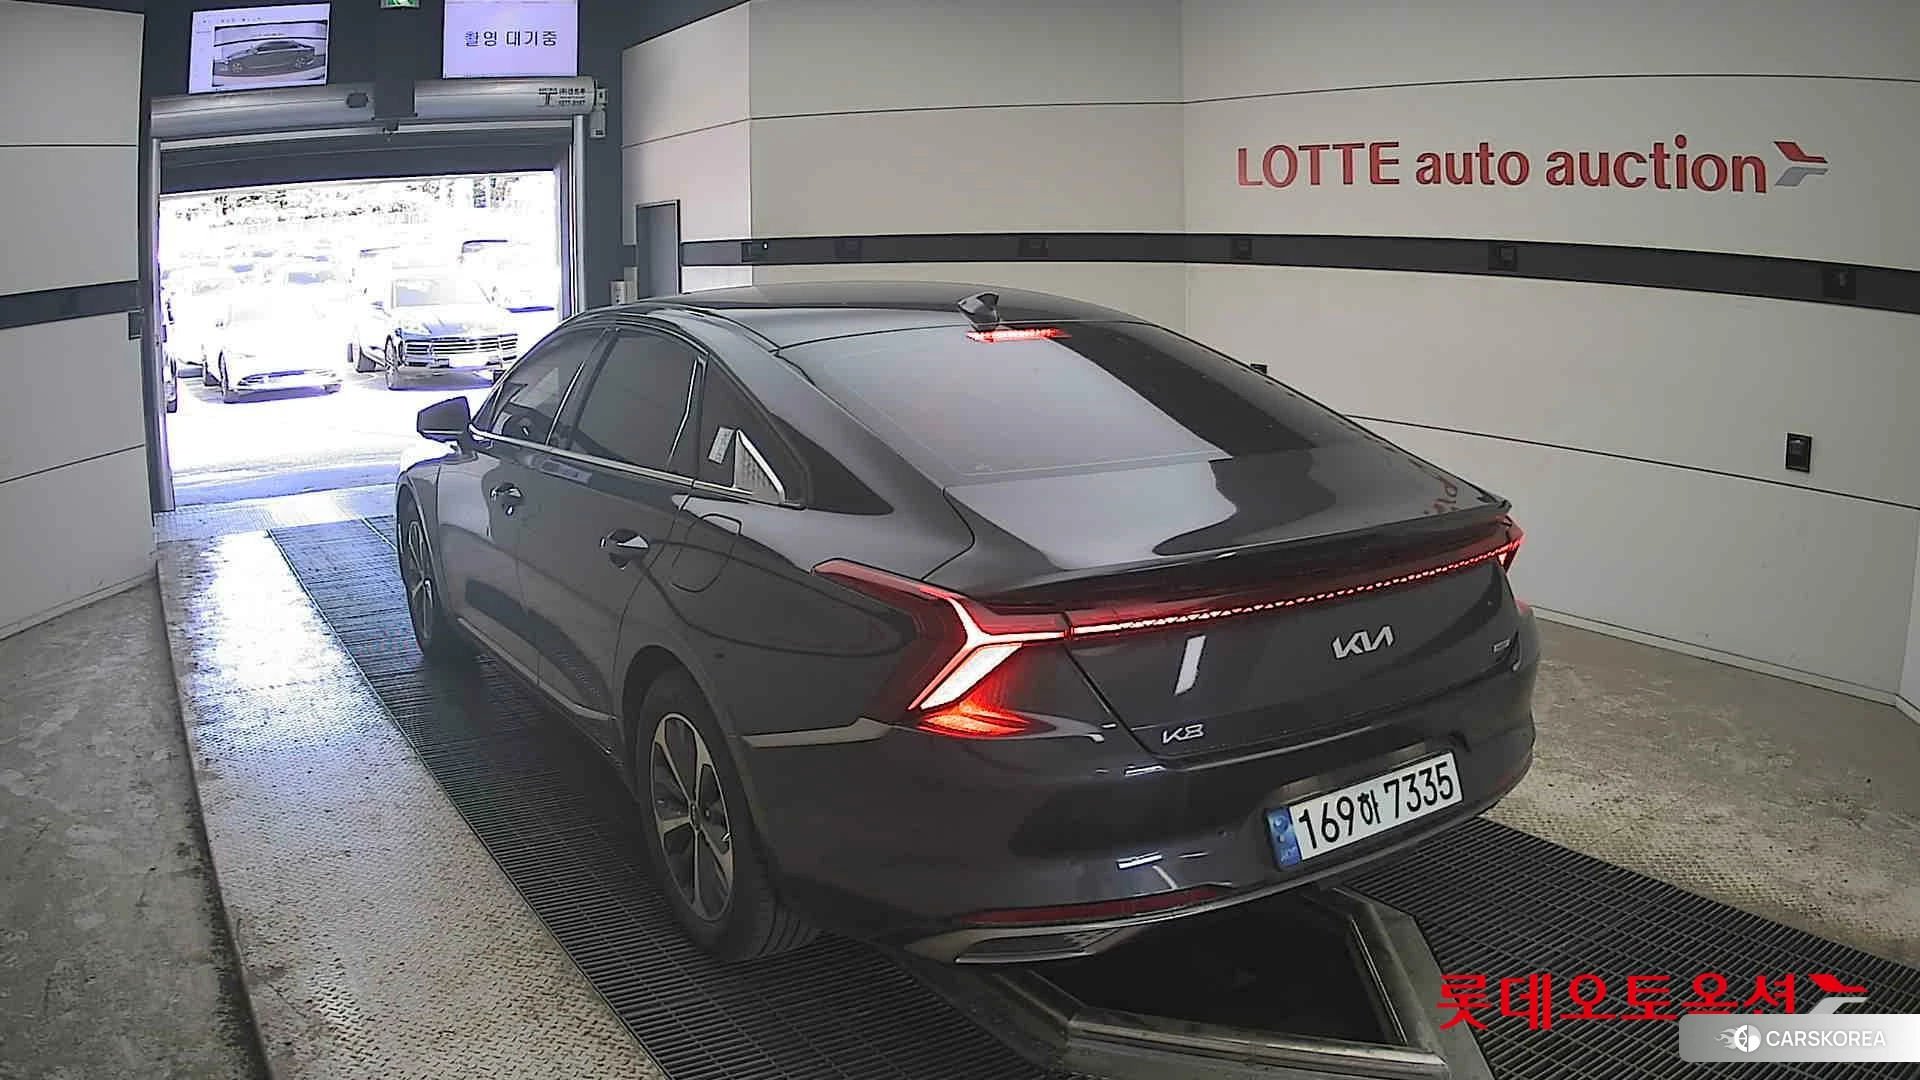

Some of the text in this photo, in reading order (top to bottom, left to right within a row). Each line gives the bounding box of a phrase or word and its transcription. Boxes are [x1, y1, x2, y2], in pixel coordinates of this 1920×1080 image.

[506, 30, 557, 47] 대기중
[1237, 134, 1767, 193] LOTTE auto auction
[1162, 723, 1205, 744] K8
[1298, 761, 1454, 850] 169하 7335
